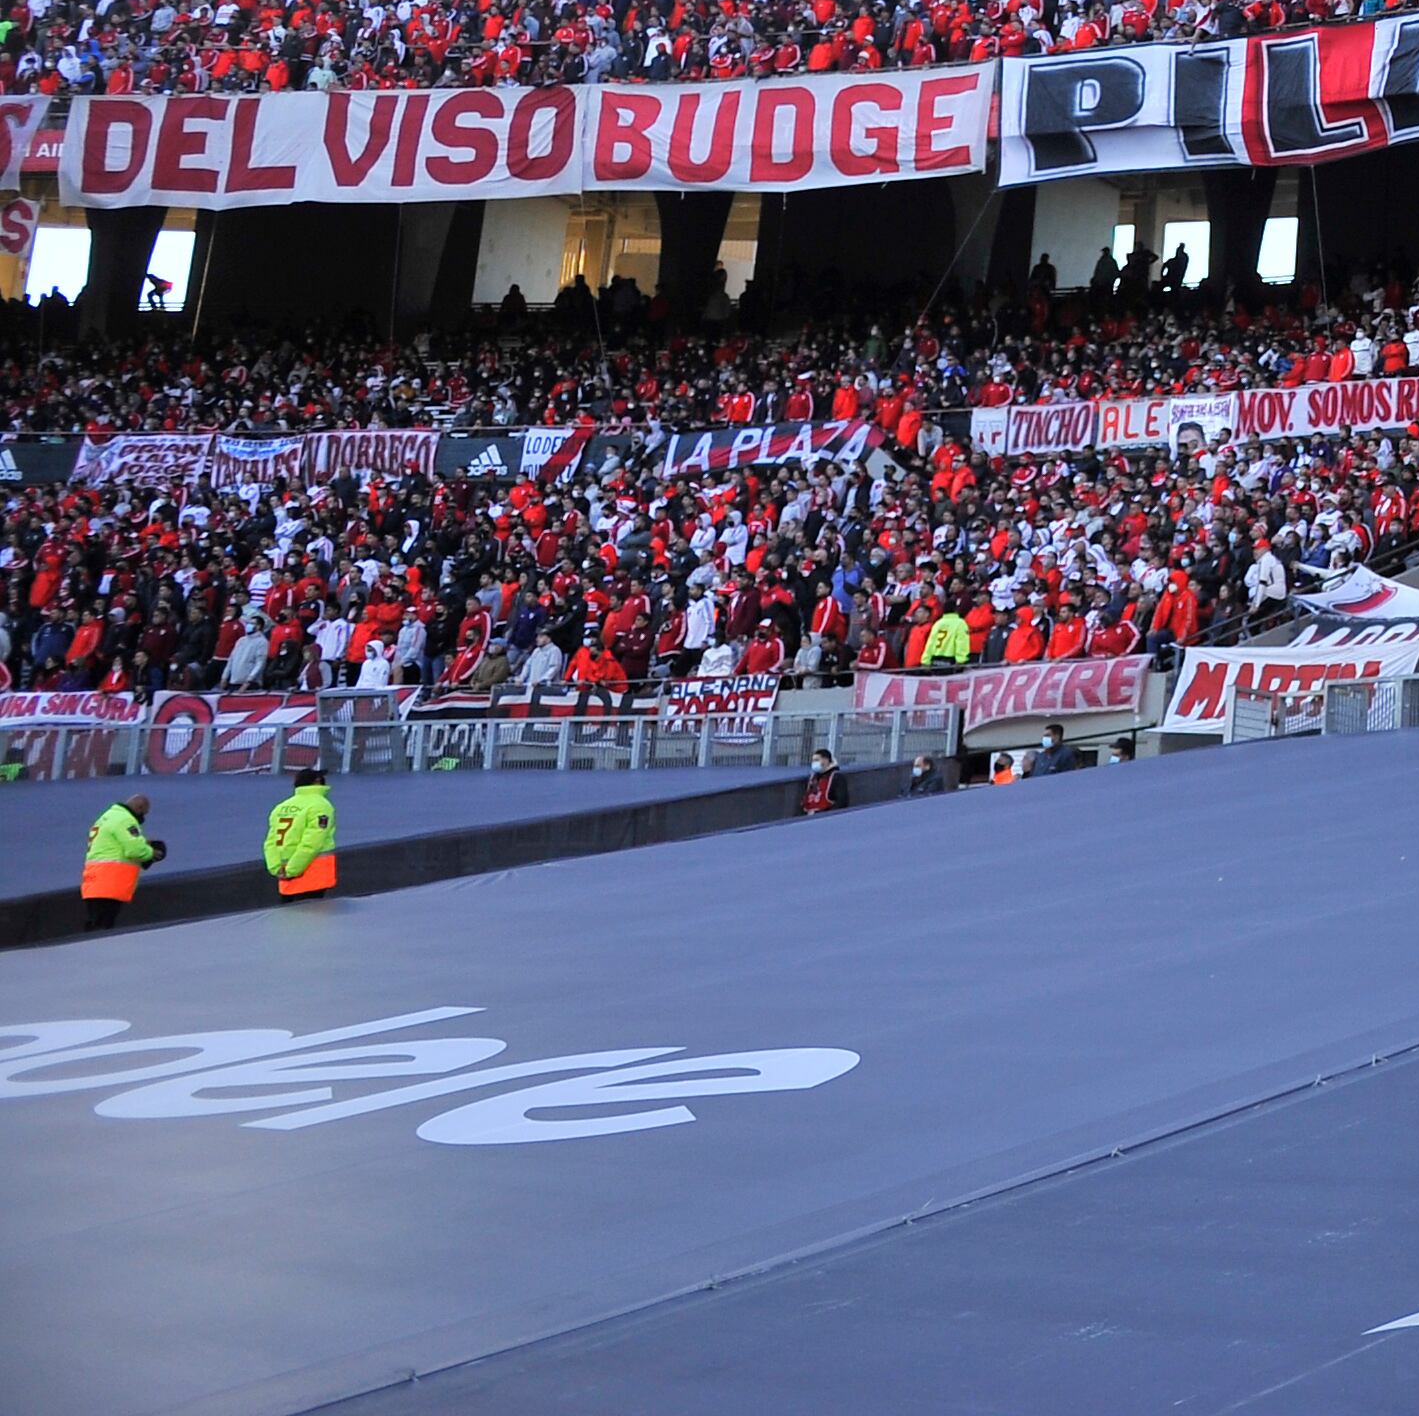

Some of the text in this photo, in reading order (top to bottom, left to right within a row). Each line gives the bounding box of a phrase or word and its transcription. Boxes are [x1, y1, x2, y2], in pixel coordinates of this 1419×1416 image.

[81, 96, 297, 195] DEL
[323, 85, 577, 188] VISO
[593, 72, 981, 184] BUDGE
[1012, 405, 1091, 450] TINCHO
[1234, 390, 1297, 441] MOV.
[1308, 385, 1392, 428] SOMOS
[662, 419, 871, 478] LA PLAZA
